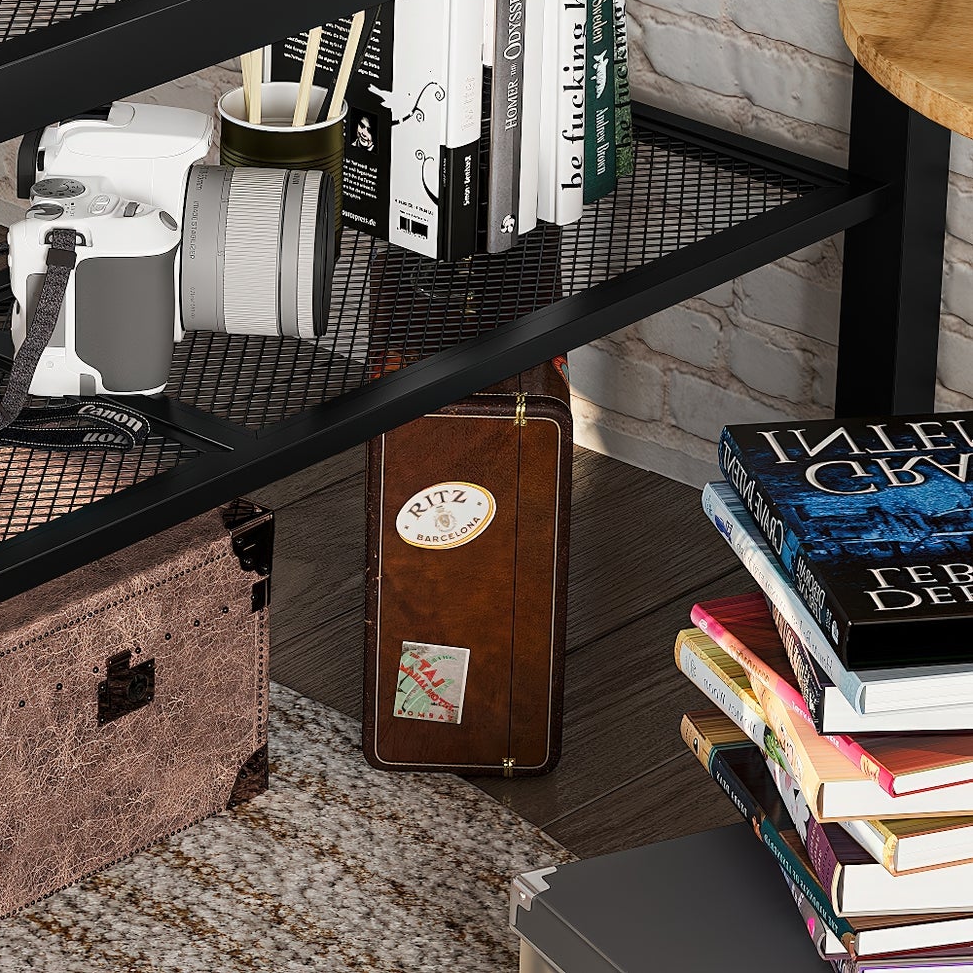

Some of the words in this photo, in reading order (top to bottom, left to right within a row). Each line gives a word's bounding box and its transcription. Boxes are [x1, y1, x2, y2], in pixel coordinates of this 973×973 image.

[561, 23, 587, 144] fucking
[504, 78, 519, 131] HOMER
[595, 107, 609, 143] Andrew
[561, 156, 583, 191] be
[78, 404, 143, 433] Canon
[408, 488, 469, 520] RITZ
[416, 515, 482, 544] BARCELONA
[418, 659, 446, 688] TAJ
[397, 709, 454, 721] BOMBAY
